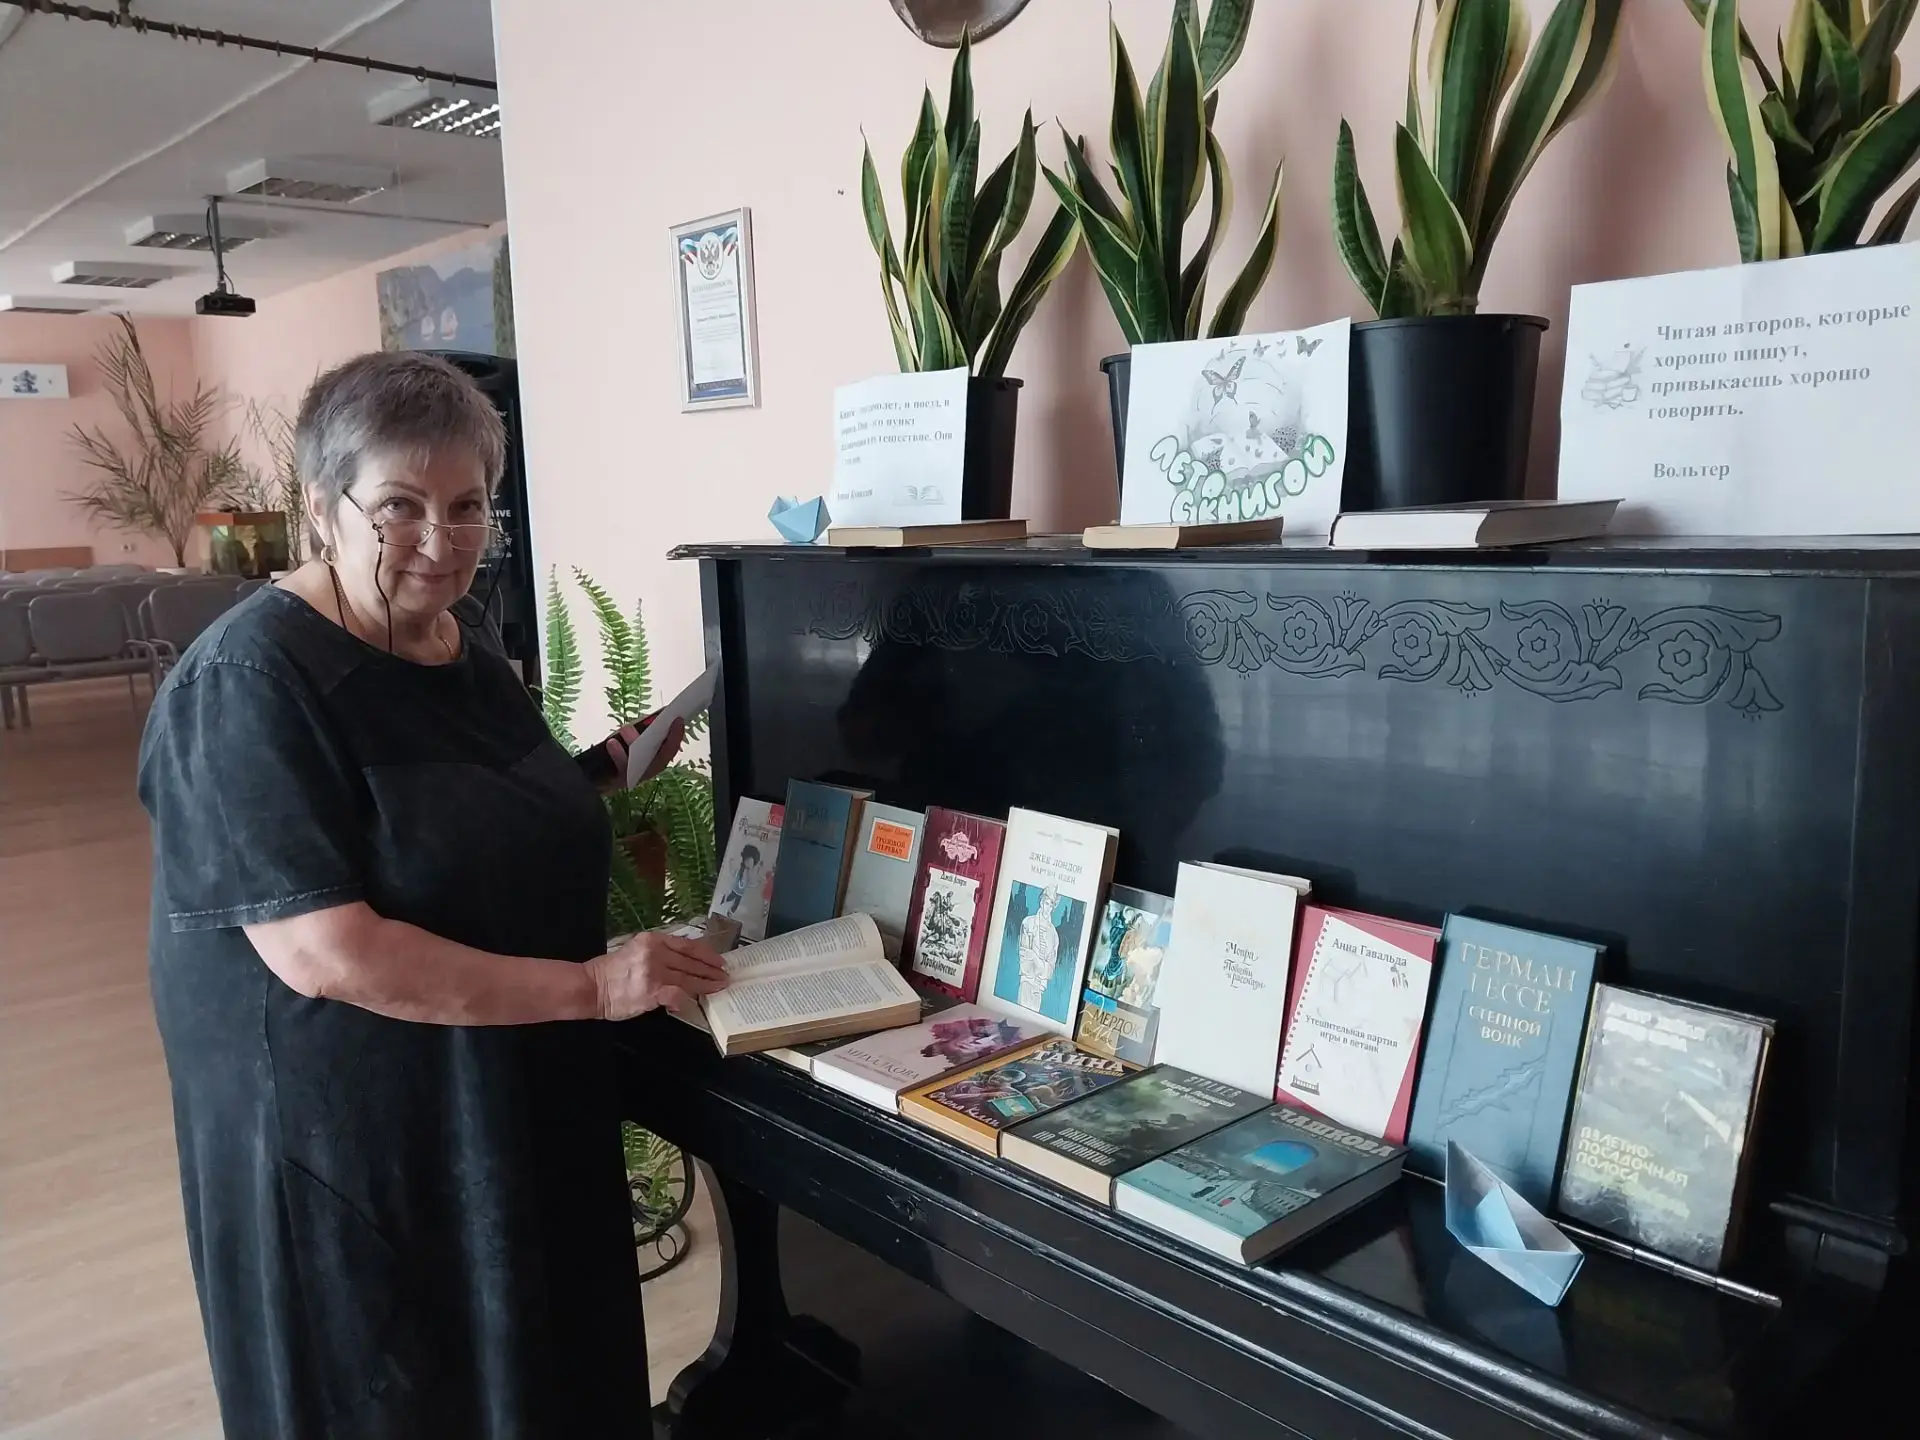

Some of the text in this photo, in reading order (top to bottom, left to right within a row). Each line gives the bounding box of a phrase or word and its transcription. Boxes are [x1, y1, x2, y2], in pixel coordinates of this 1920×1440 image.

[1657, 304, 1911, 341] Читая авторов, которые
[1653, 345, 1808, 370] хорошо пишут,
[1651, 367, 1870, 397] привыкаешь хорошо
[1648, 403, 1744, 421] говорить.
[1653, 463, 1730, 480] Вольтер
[1052, 857, 1084, 874] ЛОНДОН
[1332, 938, 1407, 968] Анна Гавальда
[1461, 941, 1577, 993] ГЕРМАН
[1470, 972, 1552, 1015] ГЕССЕ
[1093, 1009, 1142, 1037] МЕРДОК
[1305, 1014, 1398, 1049] Утешительная партия
[1468, 1005, 1542, 1037] СТЕПНОЙ
[1320, 1030, 1380, 1054] игры в петанк
[1480, 1027, 1522, 1049] ВОЛК
[1031, 1050, 1125, 1073] ТАЙНА
[1031, 1130, 1054, 1143] НА
[1270, 1108, 1396, 1158] ДАШКОВА
[1576, 1151, 1641, 1185] ПОЛОСА
[1578, 1138, 1690, 1188] ПОСАДОЧНАЯ
